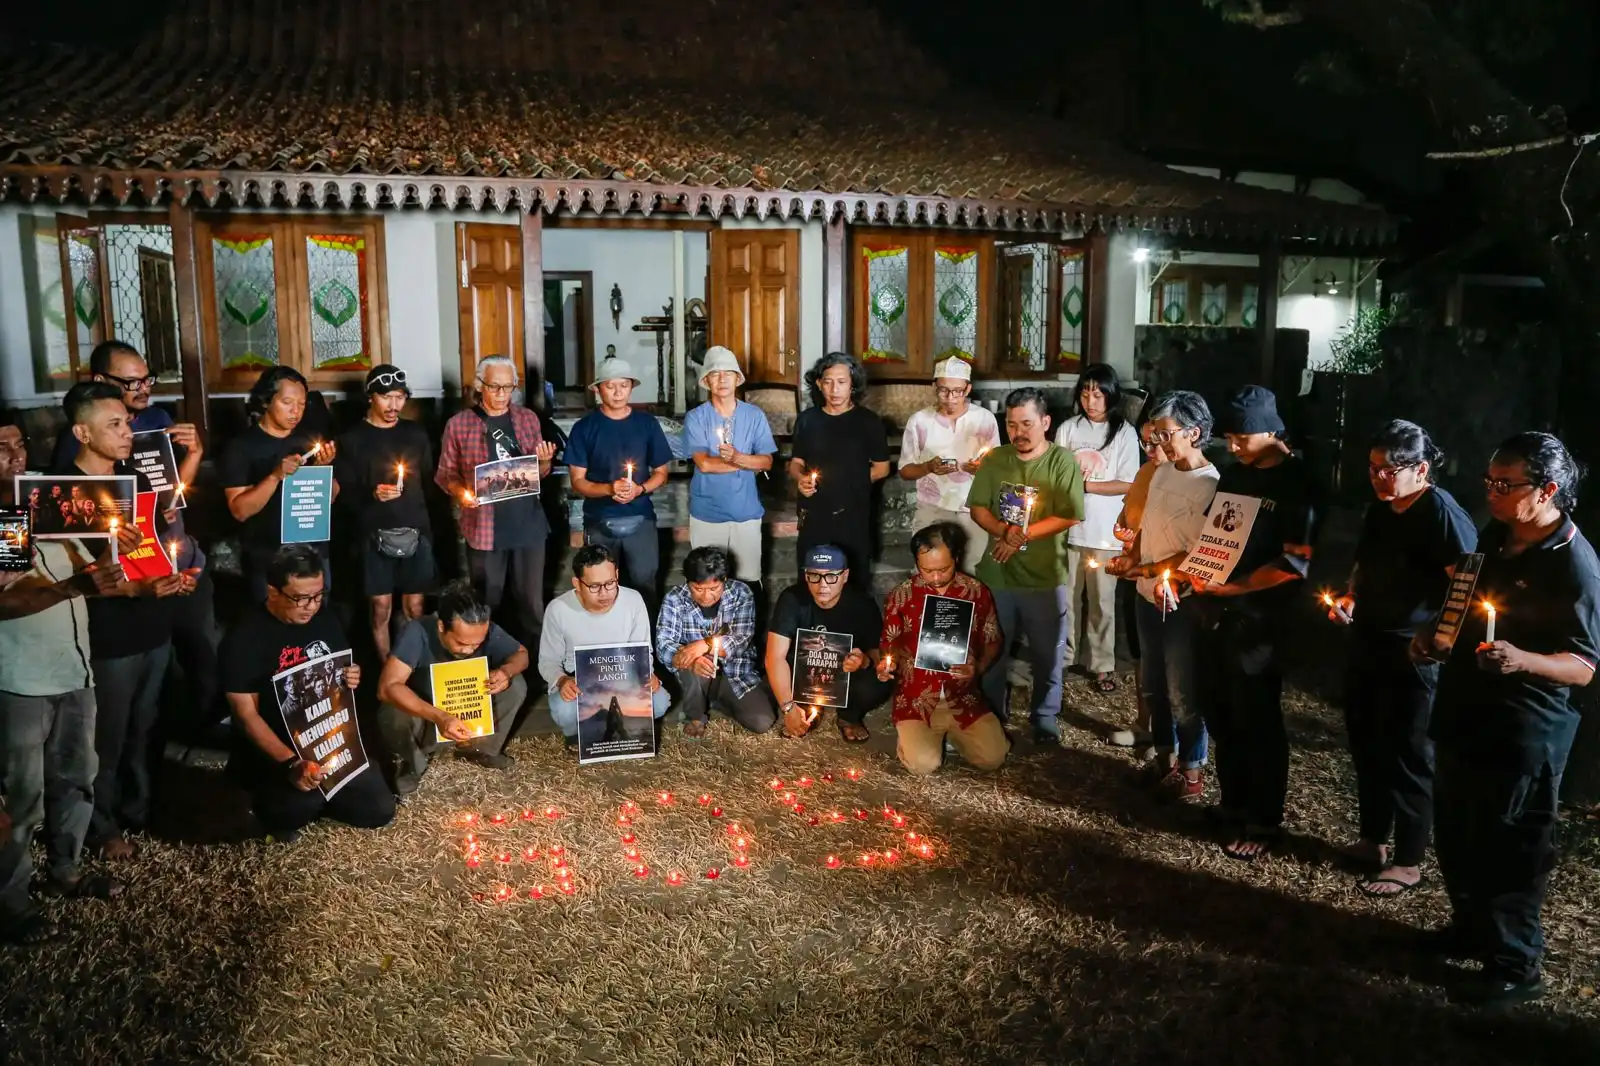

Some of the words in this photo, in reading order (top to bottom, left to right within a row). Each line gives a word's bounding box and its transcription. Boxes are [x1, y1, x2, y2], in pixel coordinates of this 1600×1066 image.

[1201, 534, 1224, 545] TIDAK
[1224, 540, 1240, 549] ADA
[1198, 546, 1230, 560] BERITA
[1189, 556, 1225, 571] SEHARGA
[1185, 566, 1214, 579] NYAWA
[589, 654, 635, 665] MENGETUK
[809, 651, 822, 659] DOA
[600, 664, 625, 672] PINTU
[807, 658, 838, 668] HARAPAN
[598, 673, 628, 681] LANGIT
[304, 697, 332, 723] KAMI
[298, 708, 350, 748] MENUNGGU
[313, 731, 345, 761] KALIAN
